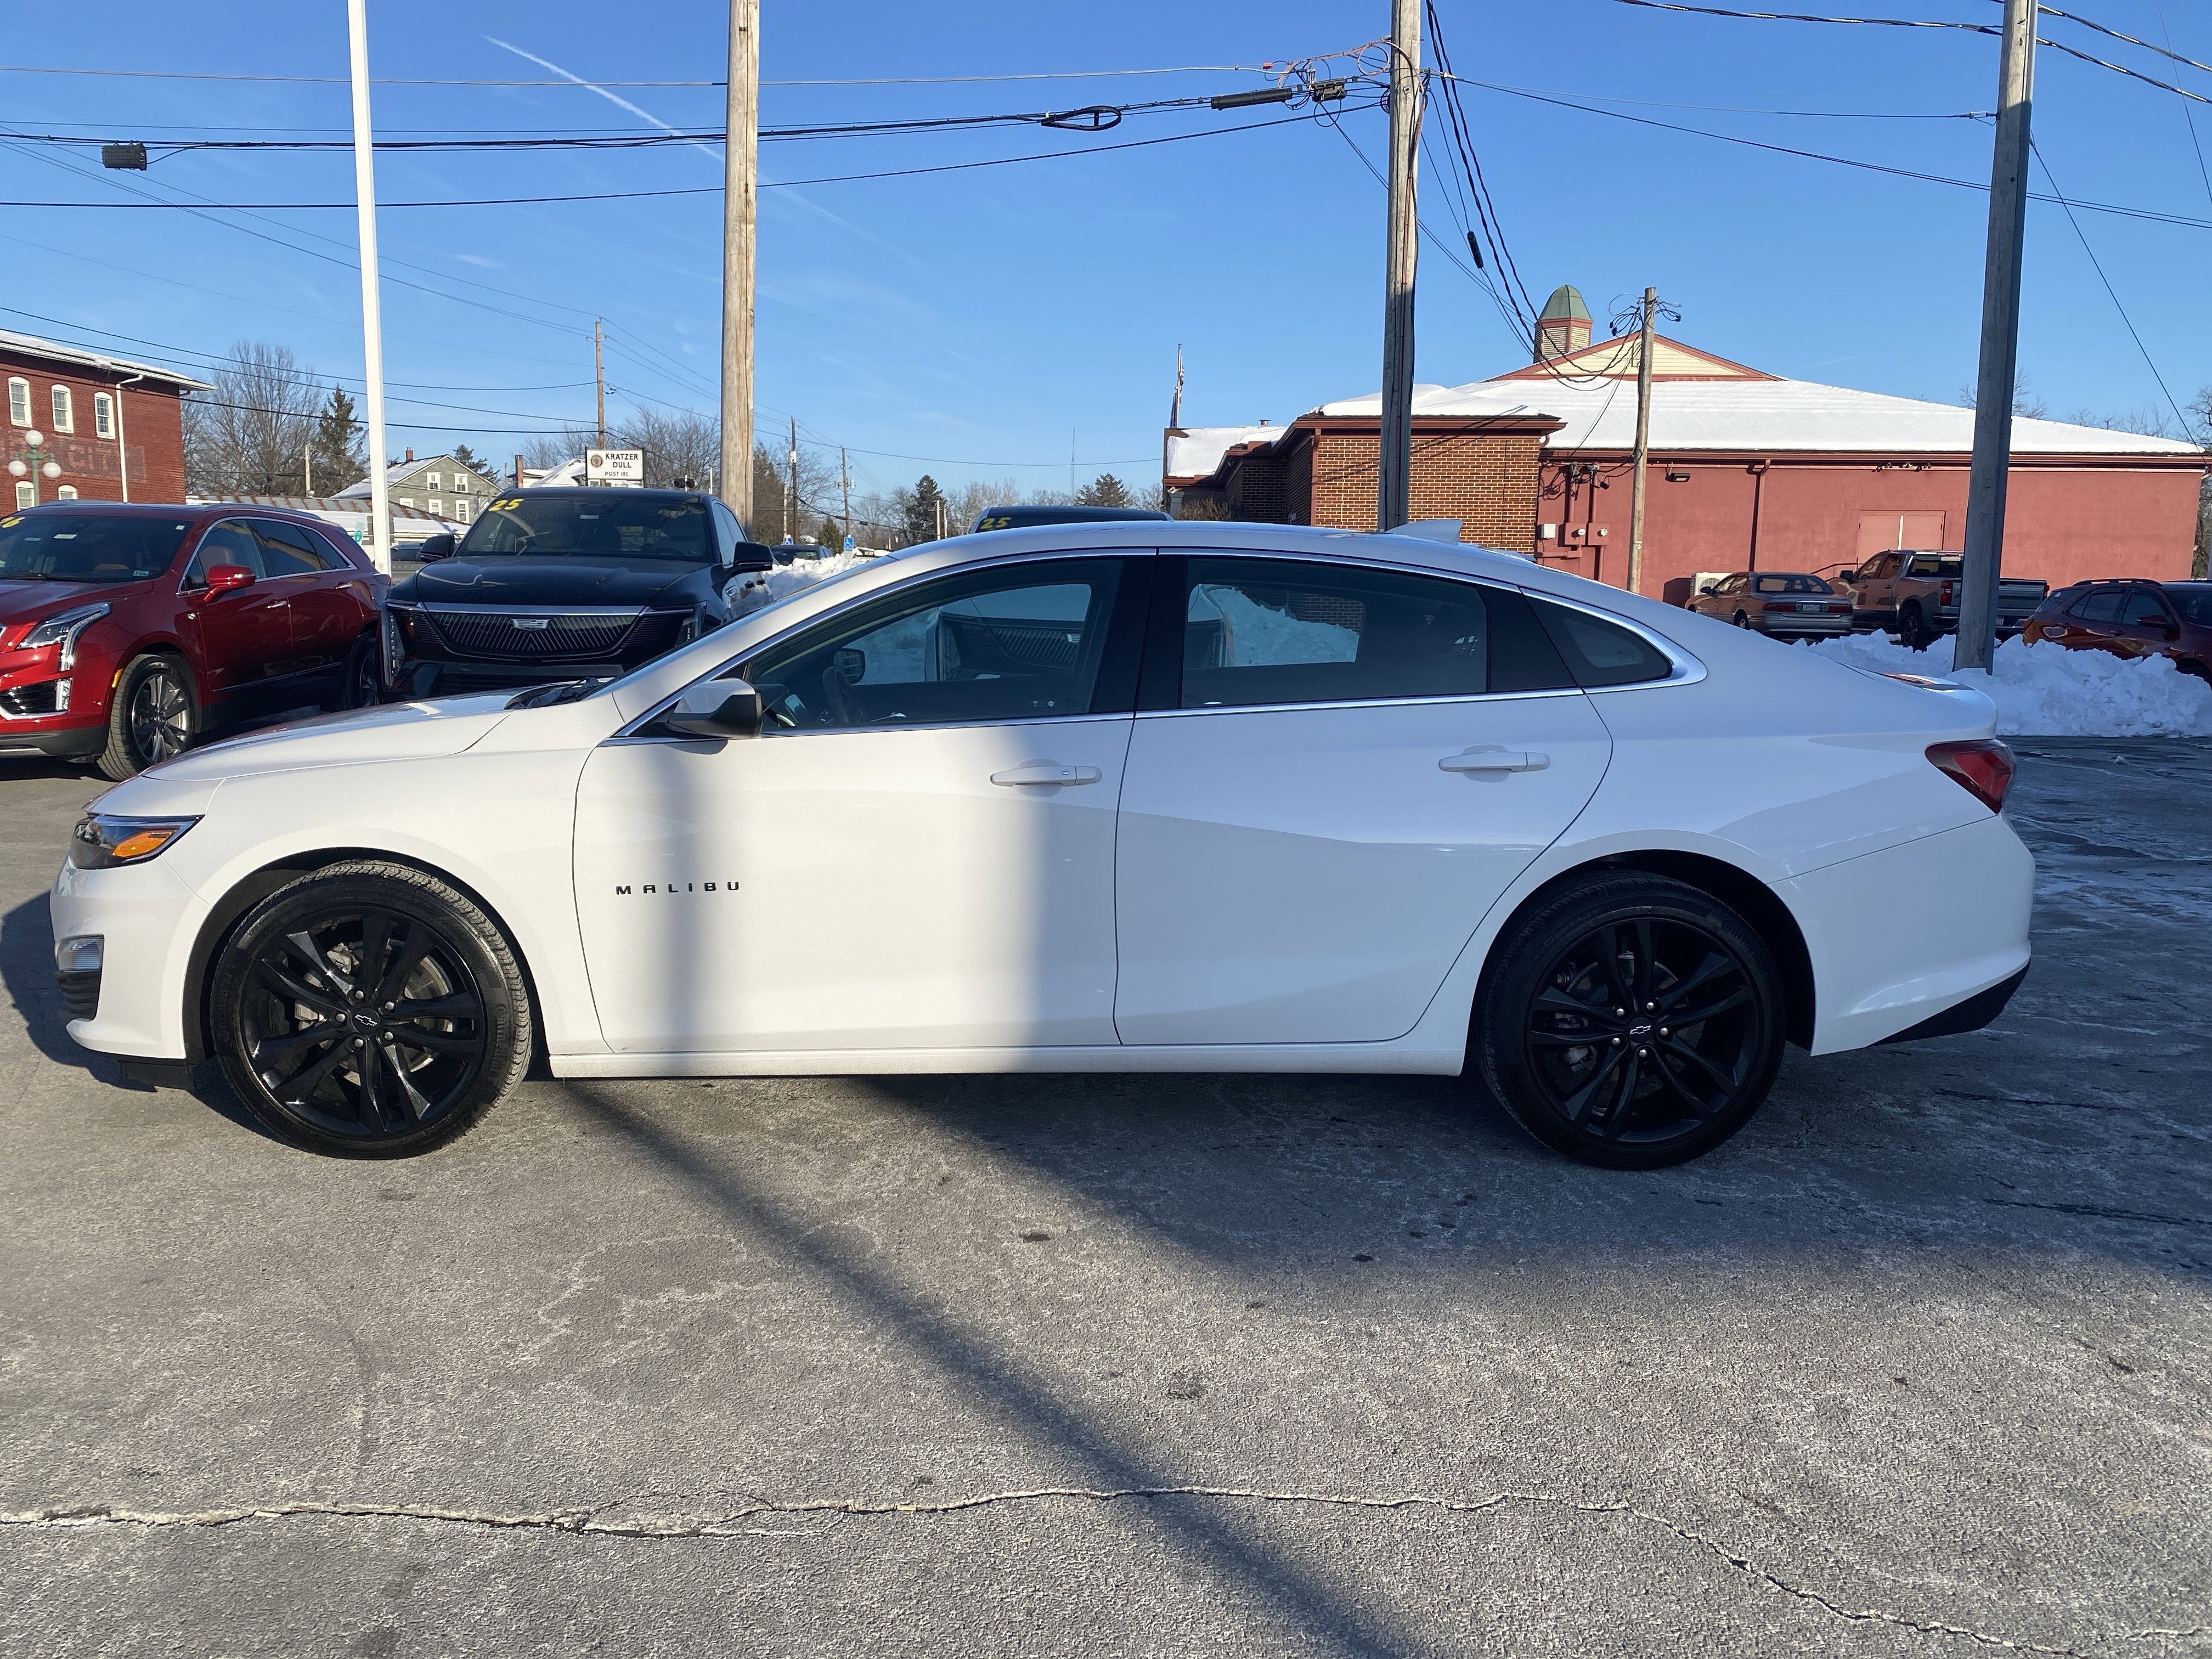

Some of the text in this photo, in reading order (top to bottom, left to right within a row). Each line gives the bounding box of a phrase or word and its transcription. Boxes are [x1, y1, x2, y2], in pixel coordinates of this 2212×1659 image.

[488, 499, 524, 511] 25
[980, 517, 1012, 529] 25
[616, 881, 740, 895] MALIBU
